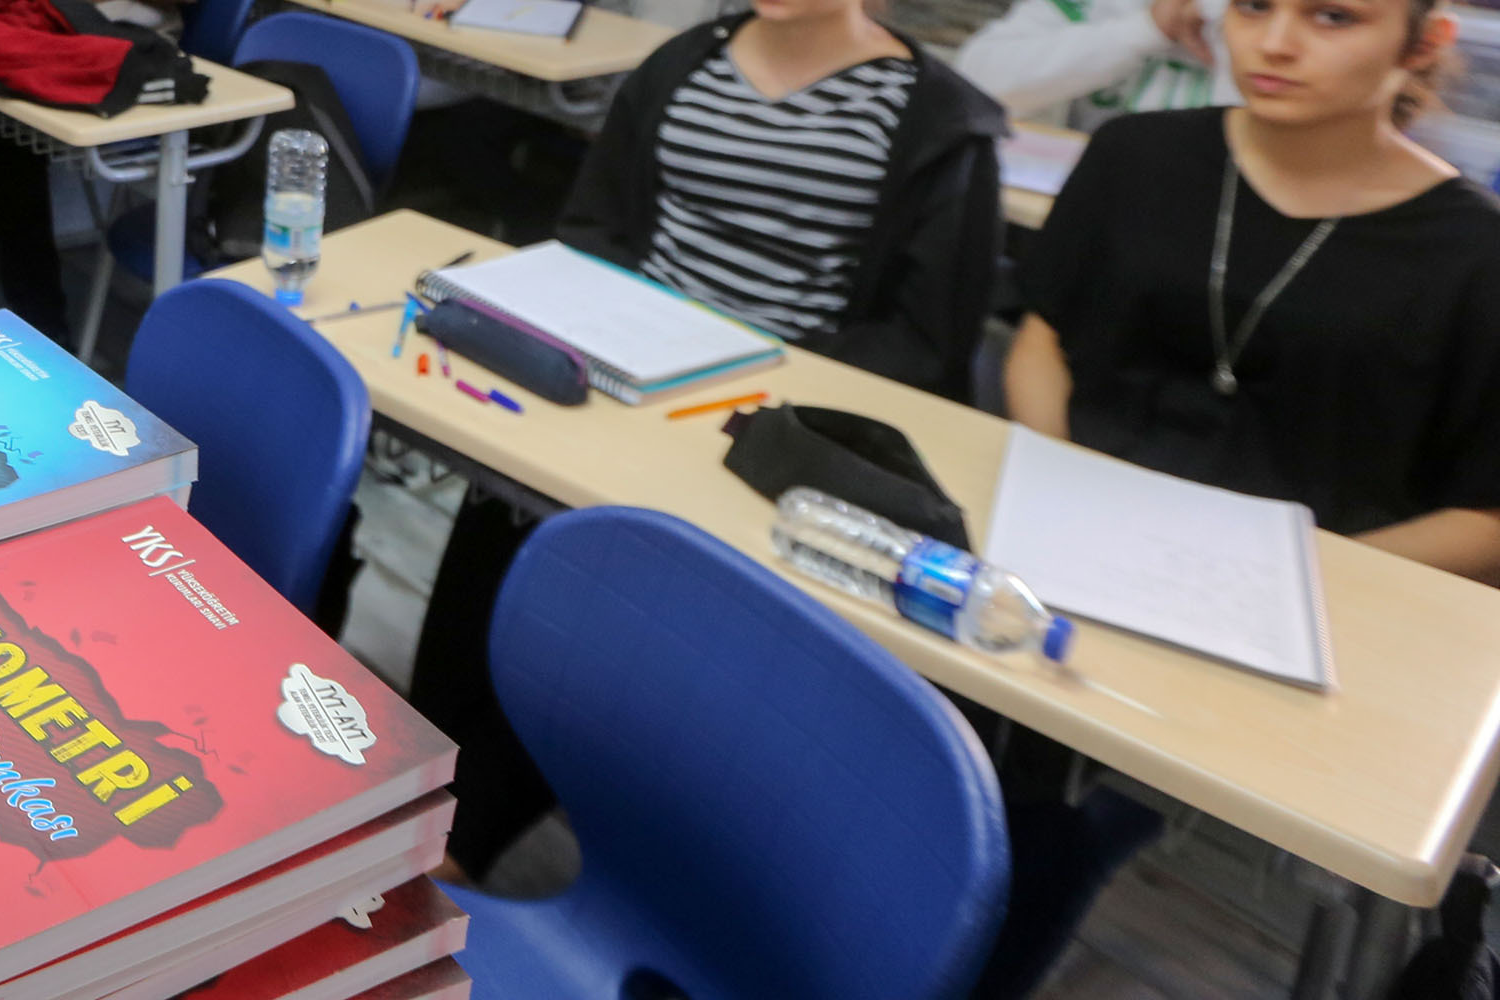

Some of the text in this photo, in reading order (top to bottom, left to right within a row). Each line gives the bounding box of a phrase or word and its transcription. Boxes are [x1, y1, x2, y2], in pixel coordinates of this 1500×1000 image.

[121, 524, 184, 568] YKS
[164, 573, 228, 630] KURUMLARI SINAVI
[315, 684, 369, 741] TYT-AYT
